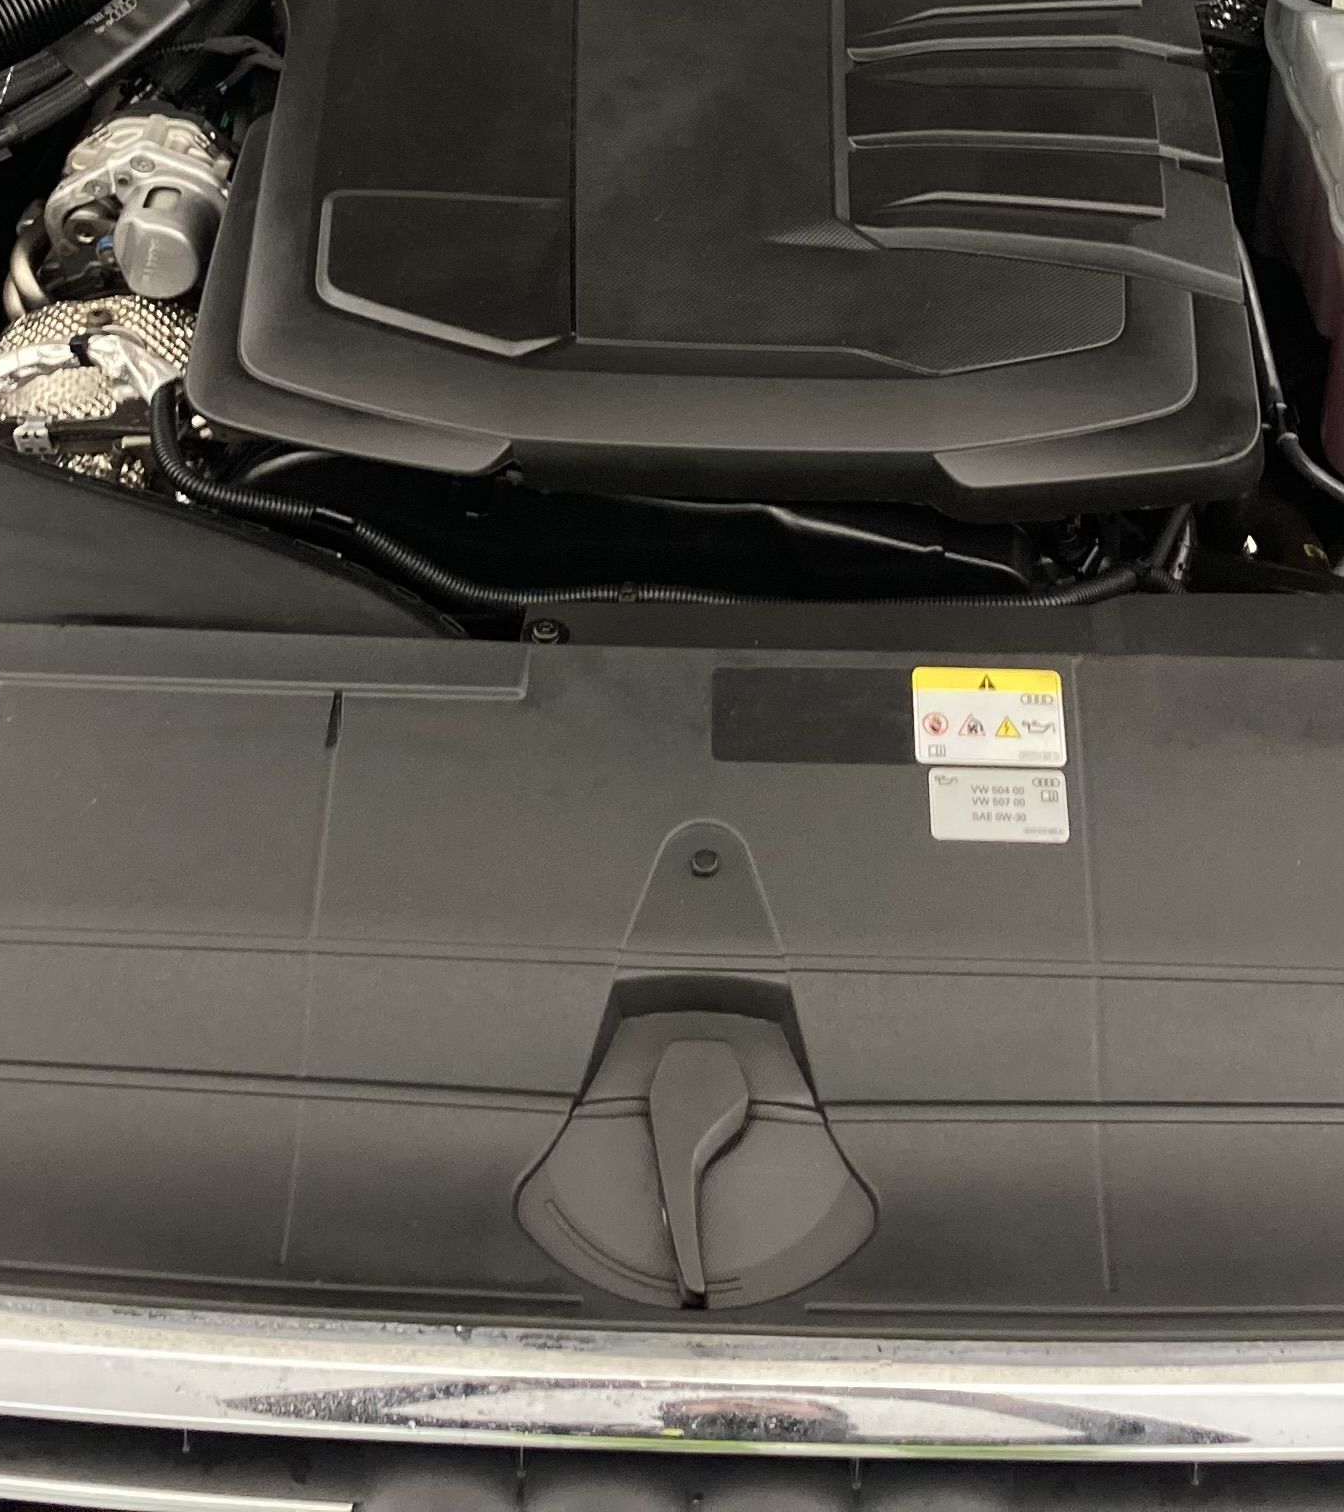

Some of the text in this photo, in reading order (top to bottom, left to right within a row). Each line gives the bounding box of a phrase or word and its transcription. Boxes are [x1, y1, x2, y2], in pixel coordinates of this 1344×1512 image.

[971, 785, 989, 794] VW
[1013, 786, 1024, 795] 00
[972, 797, 989, 806] VW
[1013, 799, 1025, 807] 00
